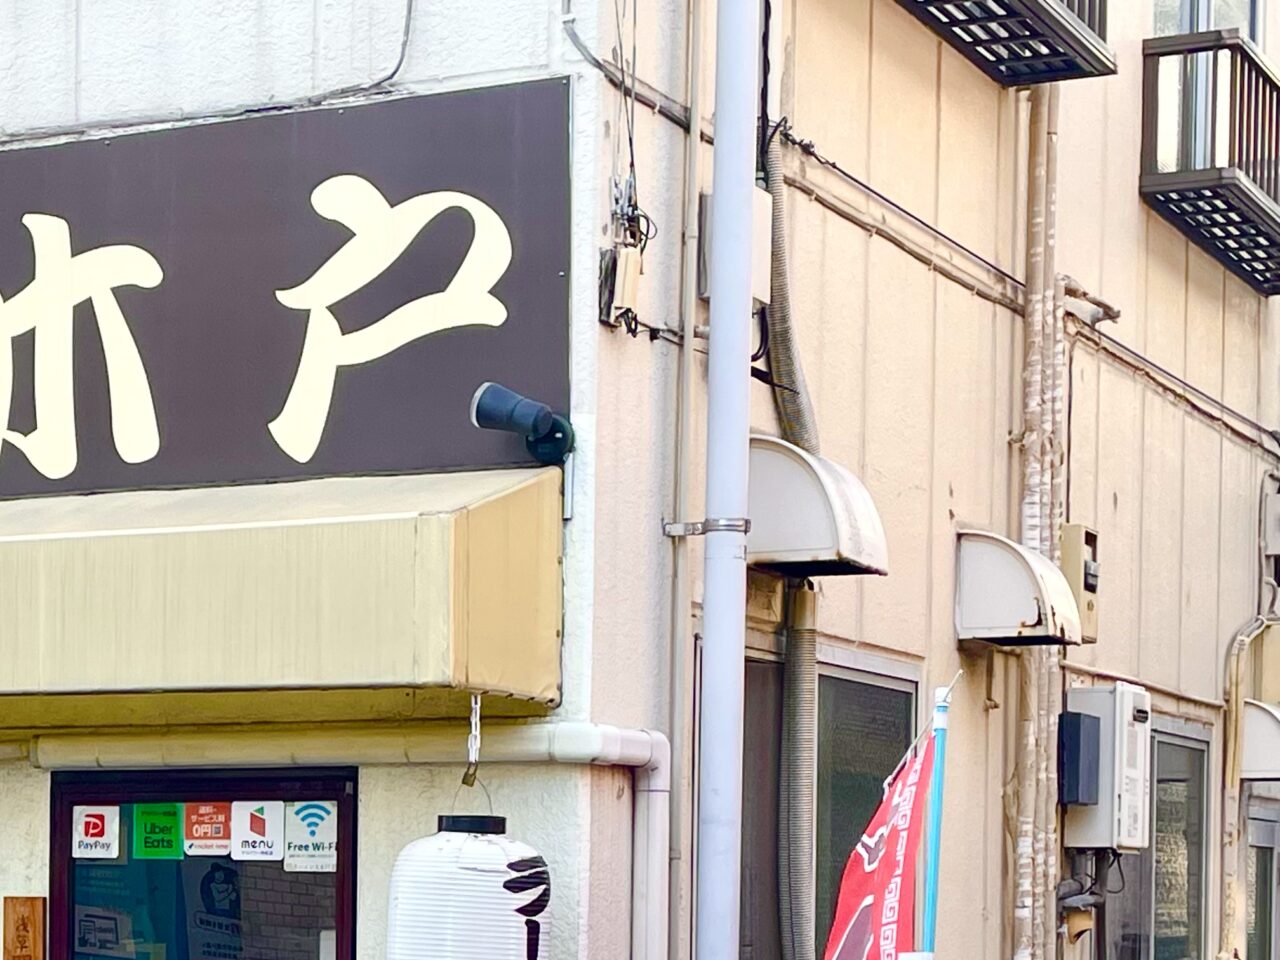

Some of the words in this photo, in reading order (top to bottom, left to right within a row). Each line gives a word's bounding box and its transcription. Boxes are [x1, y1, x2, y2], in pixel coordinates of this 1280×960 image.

[143, 822, 174, 835] Uber
[77, 840, 112, 851] PayPay
[143, 836, 174, 849] Eats
[241, 839, 274, 849] menu
[287, 841, 310, 851] Free
